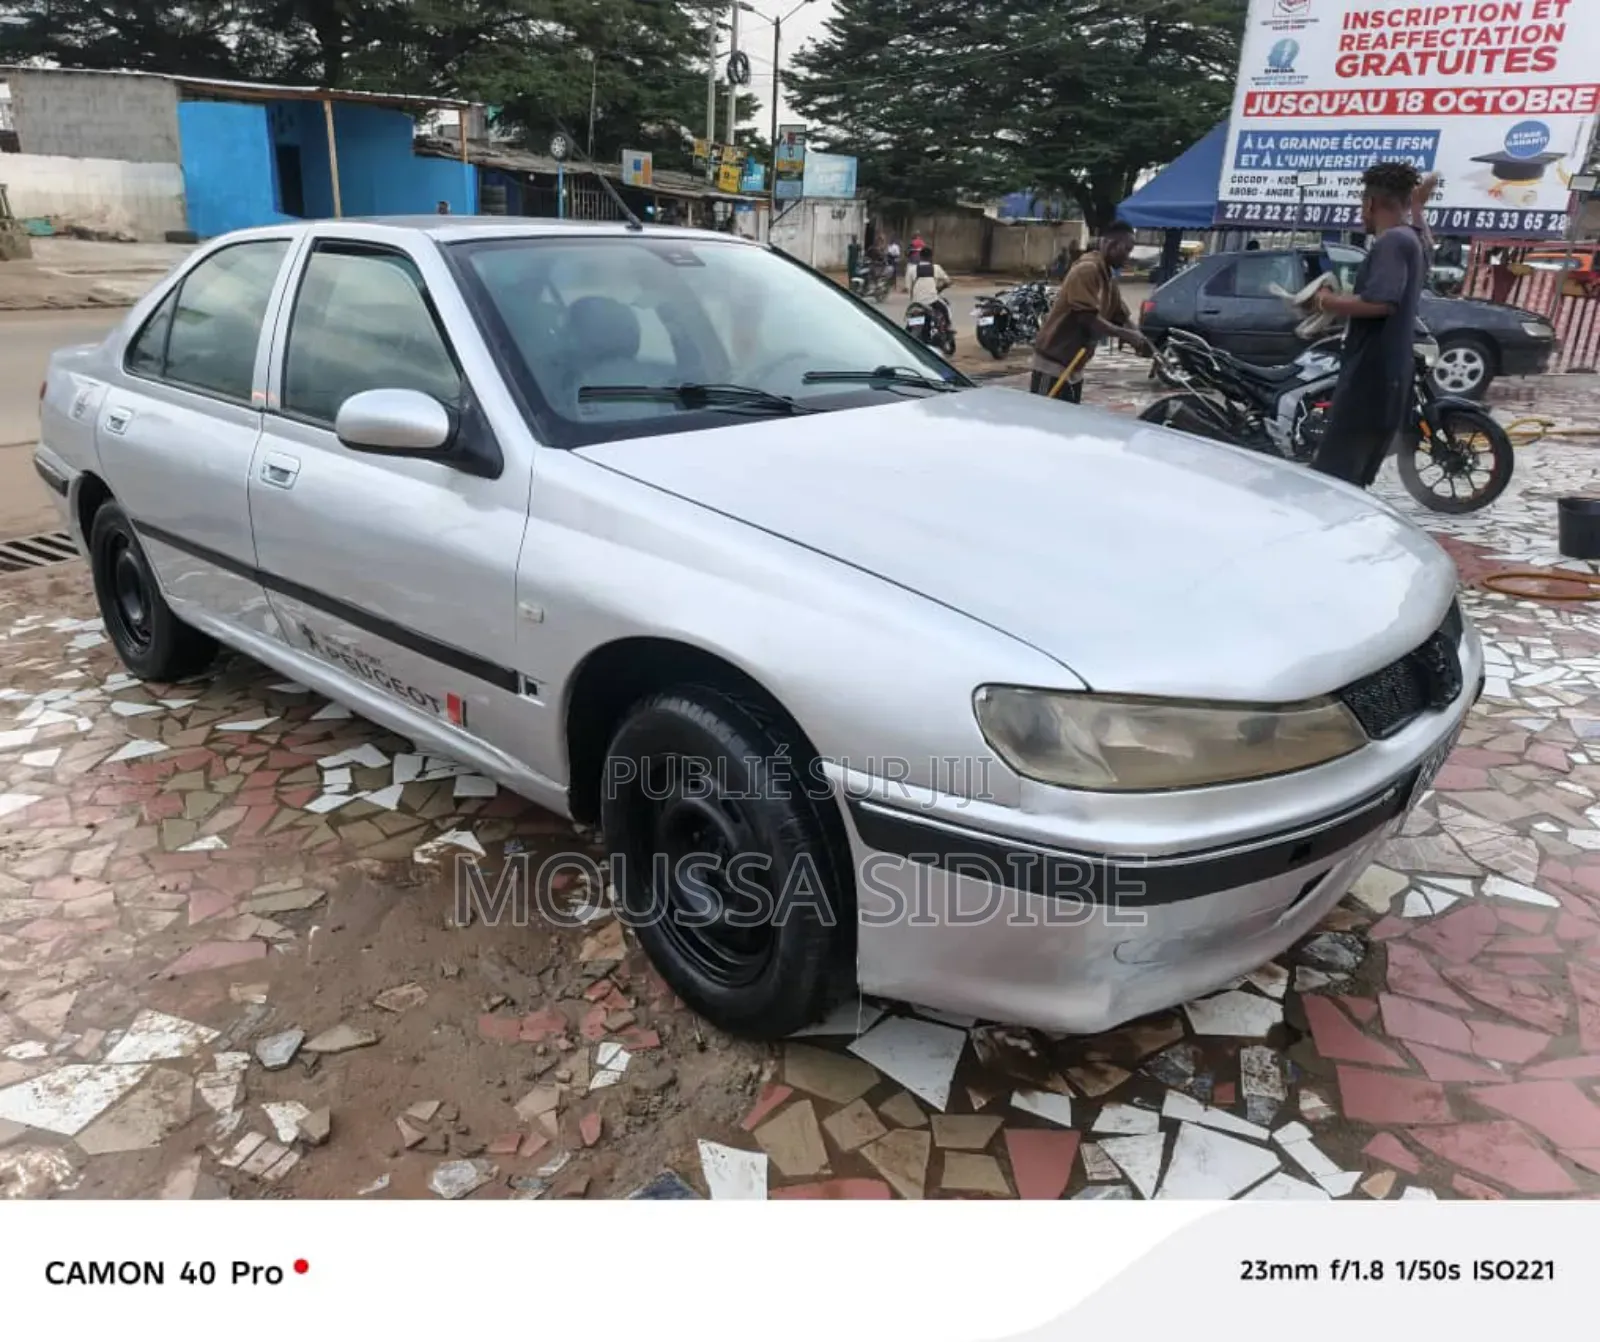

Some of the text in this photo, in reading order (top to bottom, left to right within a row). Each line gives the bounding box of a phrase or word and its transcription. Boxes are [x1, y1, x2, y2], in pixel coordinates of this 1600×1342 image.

[1342, 0, 1571, 30] INSCRIPTION ET
[1339, 23, 1566, 52] REAFFECTATION
[1335, 46, 1558, 78] GRATUITES
[1247, 87, 1596, 115] JUSQU'AU 18 OCTOBRE
[1243, 133, 1434, 150] À LA GRANDE ÉCOLE IFSM
[1240, 154, 1259, 167] ET
[1275, 152, 1377, 168] L'UNIVERSITÉ
[1225, 203, 1243, 219] 27
[1245, 204, 1262, 219] 22
[1264, 204, 1281, 220] 22
[1304, 206, 1322, 222] 30
[1333, 207, 1350, 222] 25
[1452, 210, 1471, 228] 01
[1476, 212, 1495, 228] 53
[1499, 212, 1518, 229] 33
[1524, 213, 1543, 230] 65
[325, 646, 441, 713] PEUGEOT
